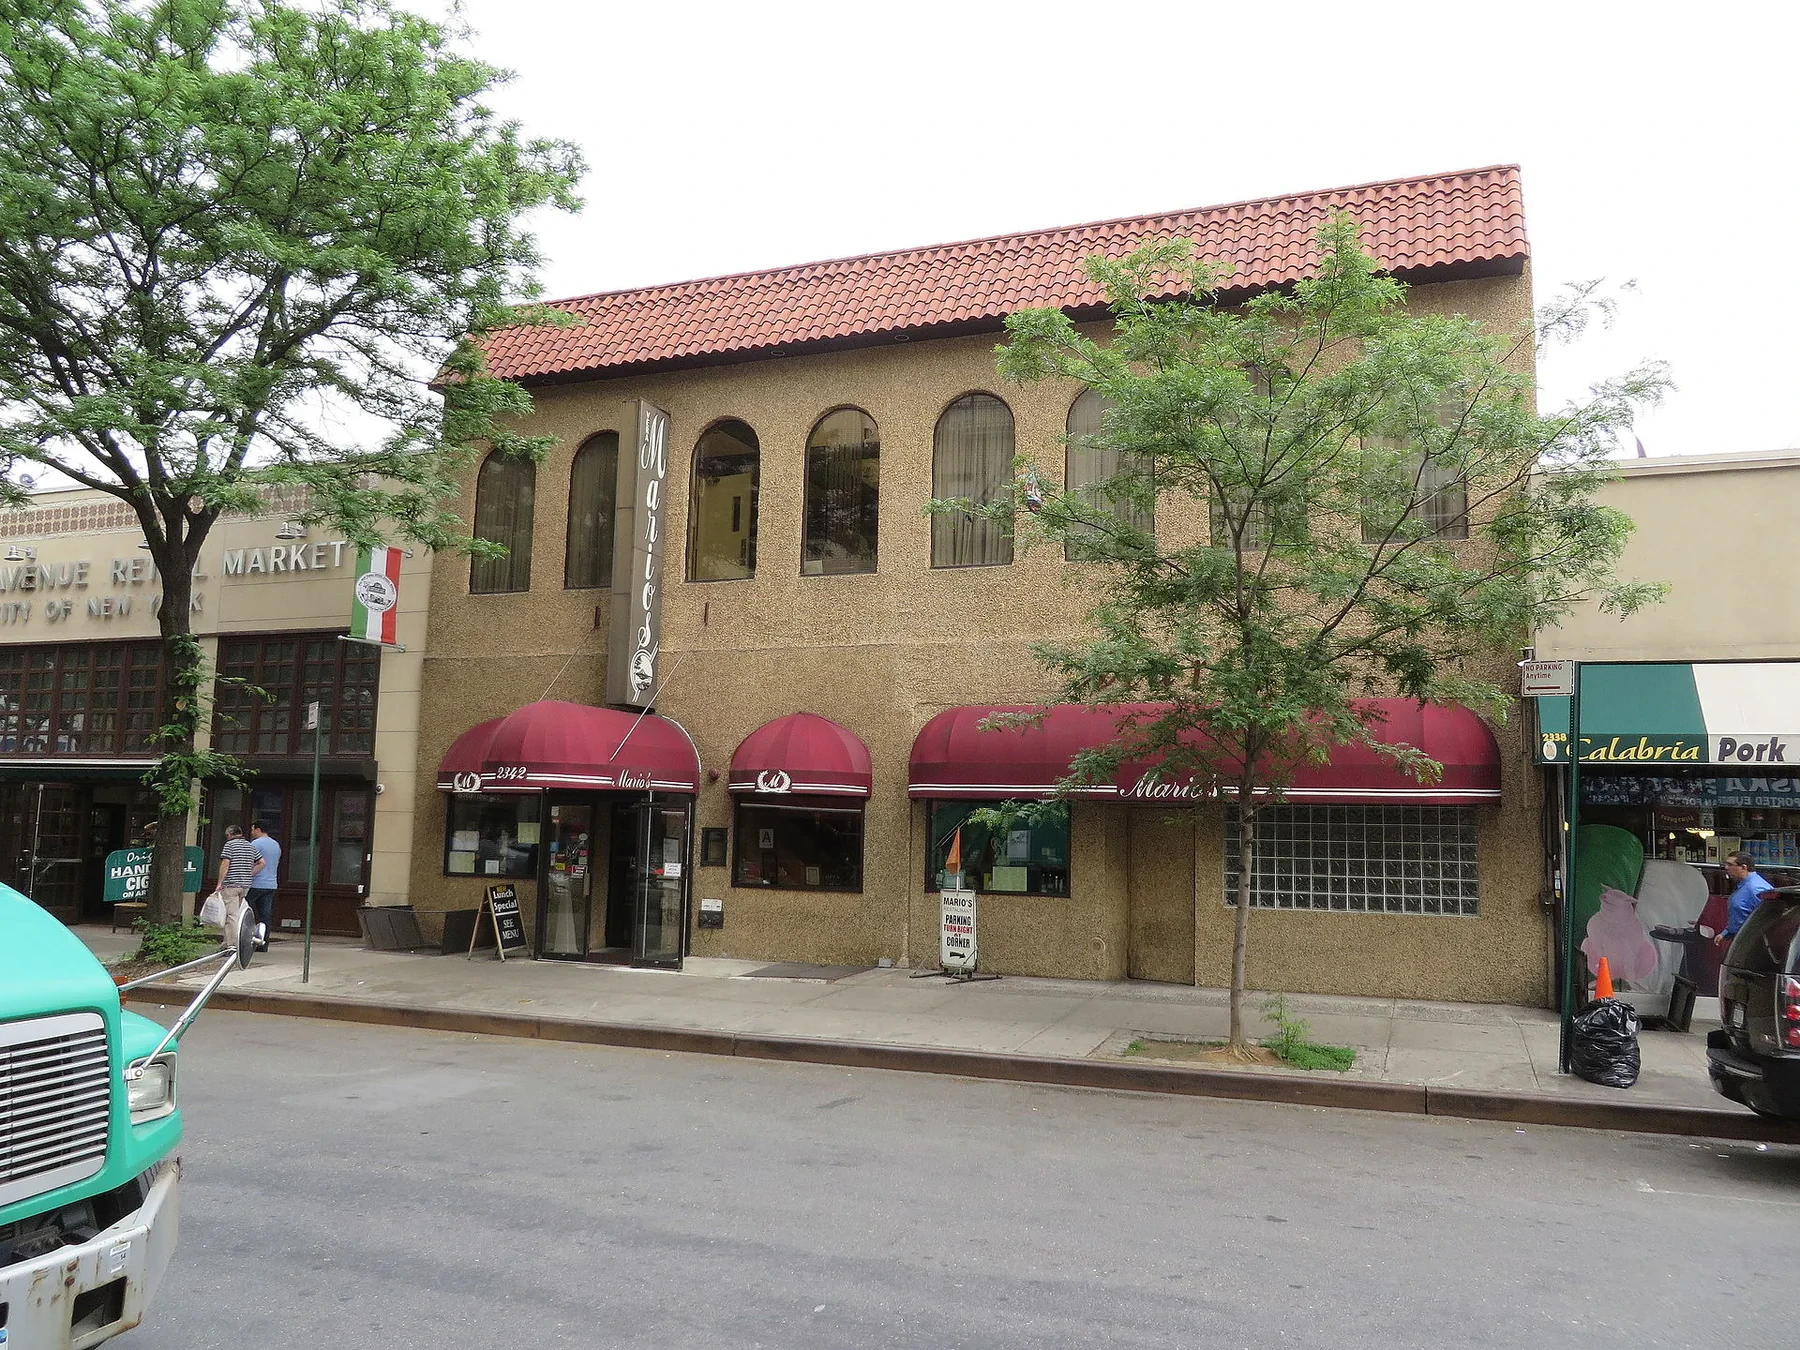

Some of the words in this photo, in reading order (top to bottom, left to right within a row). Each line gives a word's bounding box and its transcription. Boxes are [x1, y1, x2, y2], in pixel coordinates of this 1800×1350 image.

[112, 557, 207, 585] RETL
[222, 540, 347, 576] MARKET
[45, 599, 73, 622] OF
[88, 597, 133, 619] NEW
[148, 591, 204, 618] YK
[1525, 664, 1535, 672] NO
[1535, 663, 1563, 671] PARKING
[1525, 672, 1552, 680] Anytime
[1541, 733, 1568, 742] 2338
[1565, 736, 1700, 761] Calabria
[1718, 736, 1788, 762] Pork
[496, 766, 527, 780] 2342
[611, 768, 653, 789] Mario's
[1120, 771, 1218, 798] Mario's
[761, 831, 772, 843] A
[122, 891, 135, 899] ON
[492, 889, 514, 900] Lunch
[493, 900, 518, 912] Special
[944, 897, 972, 907] MARIO'S
[502, 918, 515, 929] SEE
[946, 915, 971, 925] PARKING
[502, 928, 520, 940] MENU
[944, 924, 957, 932] TURN
[957, 926, 973, 934] RIGHT
[947, 937, 970, 948] CORNER
